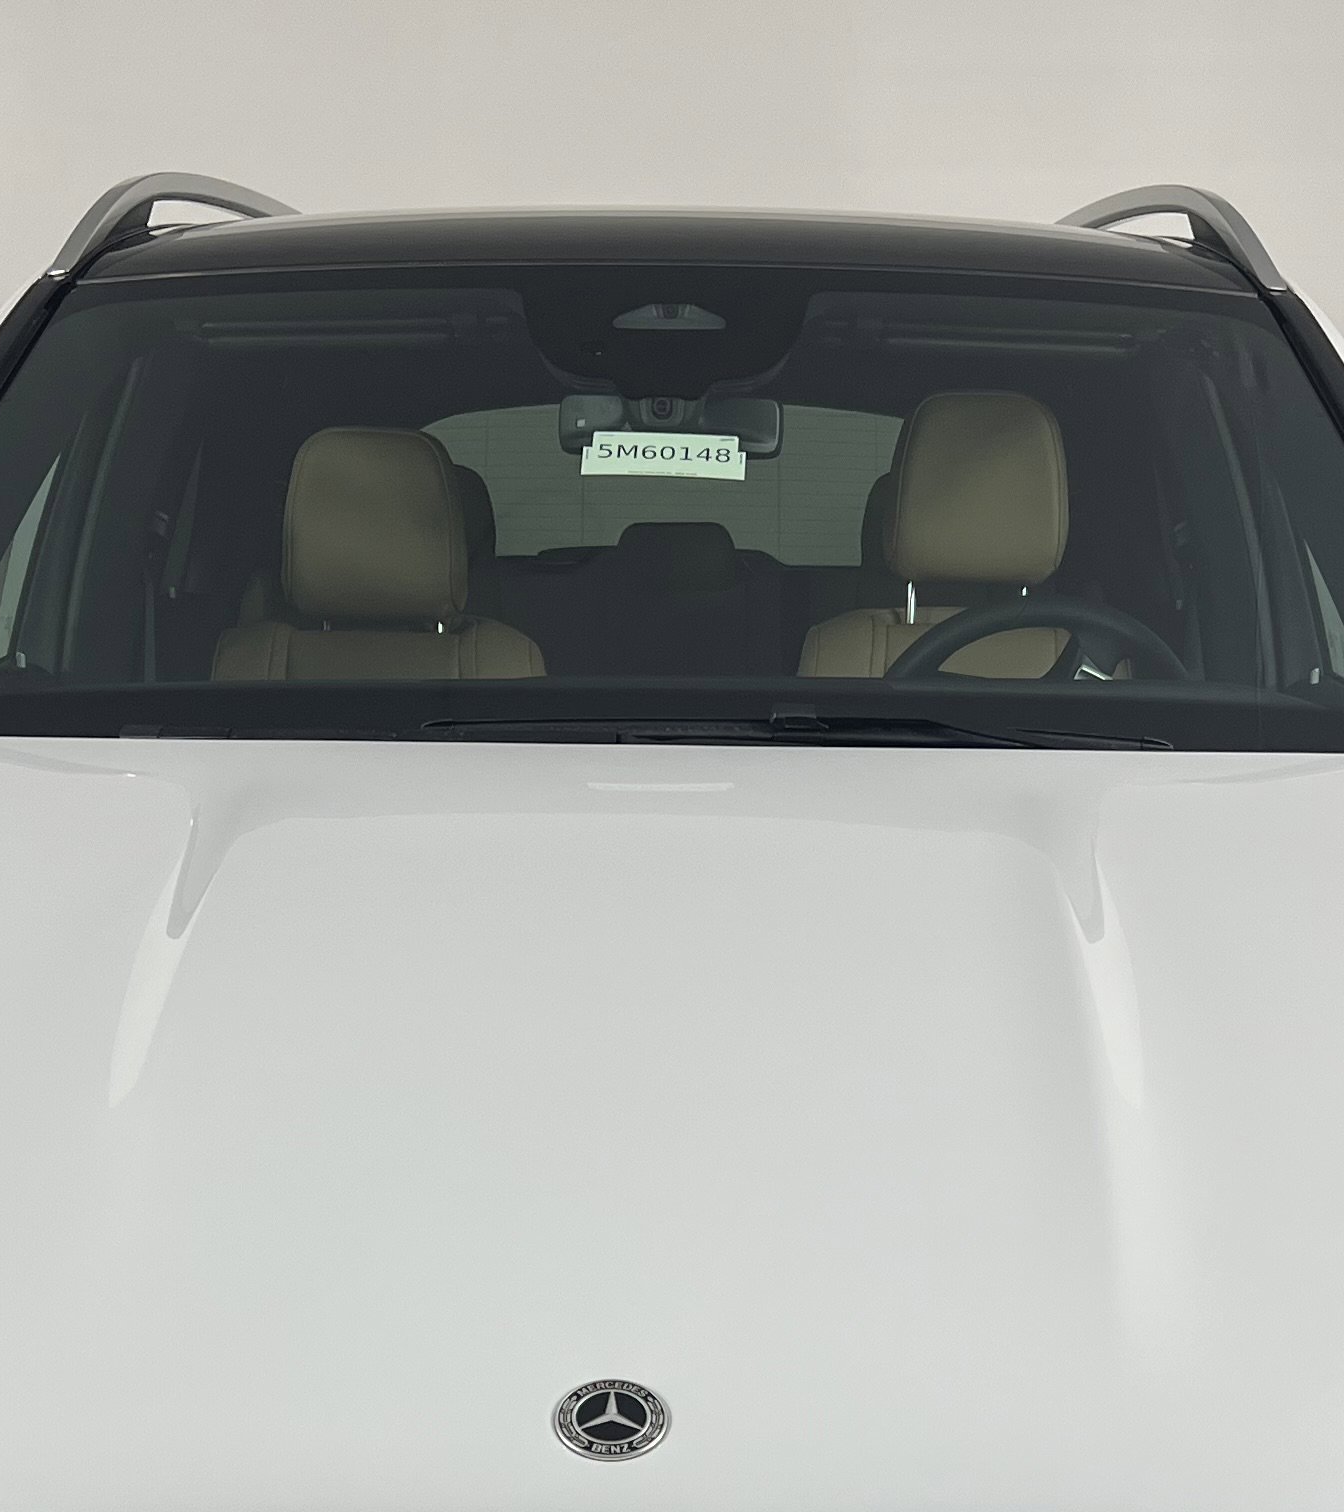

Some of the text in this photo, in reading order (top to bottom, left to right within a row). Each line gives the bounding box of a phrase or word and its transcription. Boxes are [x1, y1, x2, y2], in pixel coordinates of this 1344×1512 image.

[598, 443, 731, 464] 5M60148
[577, 1381, 649, 1397] MERCEDES
[591, 1443, 631, 1454] BENZ
